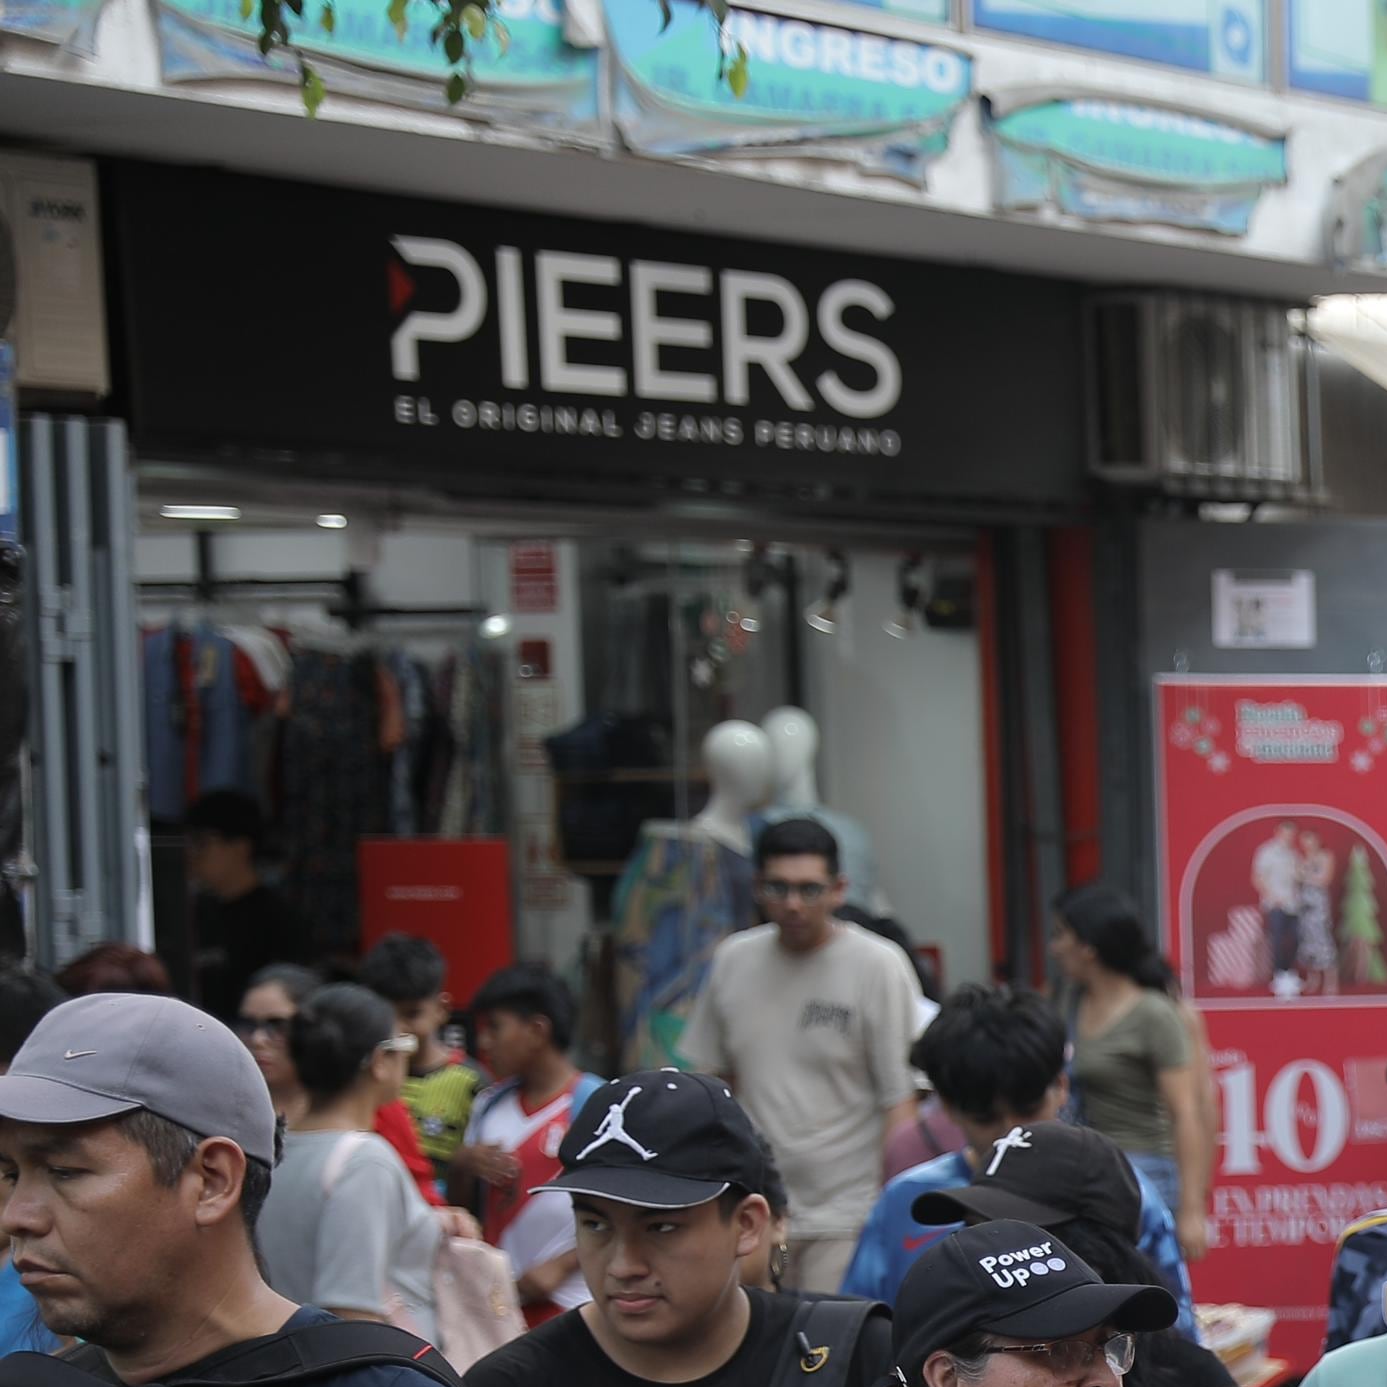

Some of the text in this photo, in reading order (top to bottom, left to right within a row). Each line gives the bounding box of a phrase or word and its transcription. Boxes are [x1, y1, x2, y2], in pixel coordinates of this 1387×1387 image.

[724, 14, 962, 96] INGRESO
[388, 234, 902, 420] PIEERS
[393, 395, 902, 457] EL ORIGINAL JEANS PERUANO
[1204, 1213, 1347, 1248] E TEMPOR
[978, 1241, 1053, 1274] Power
[991, 1267, 1031, 1289] Up
